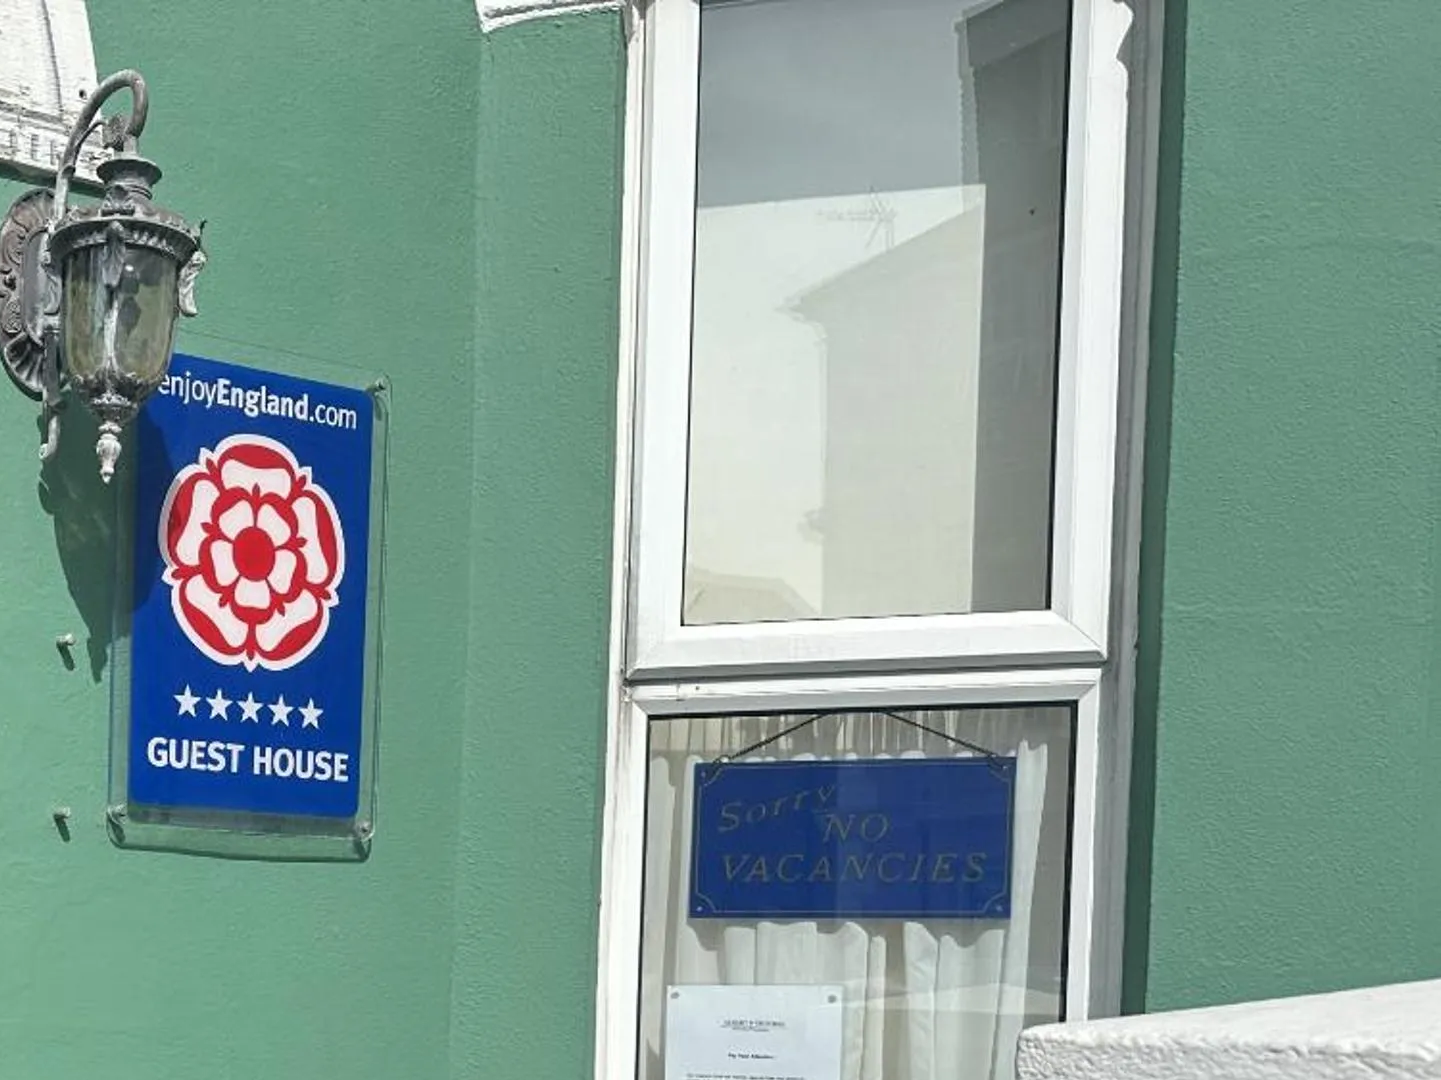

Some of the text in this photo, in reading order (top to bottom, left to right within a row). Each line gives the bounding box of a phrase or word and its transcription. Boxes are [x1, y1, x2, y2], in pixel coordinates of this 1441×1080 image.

[158, 371, 357, 430] enjoyEngland.com
[147, 736, 349, 782] GUEST HOUSE
[718, 785, 838, 833] Sorry
[822, 813, 890, 843] NO
[722, 852, 988, 884] VACANCIES
